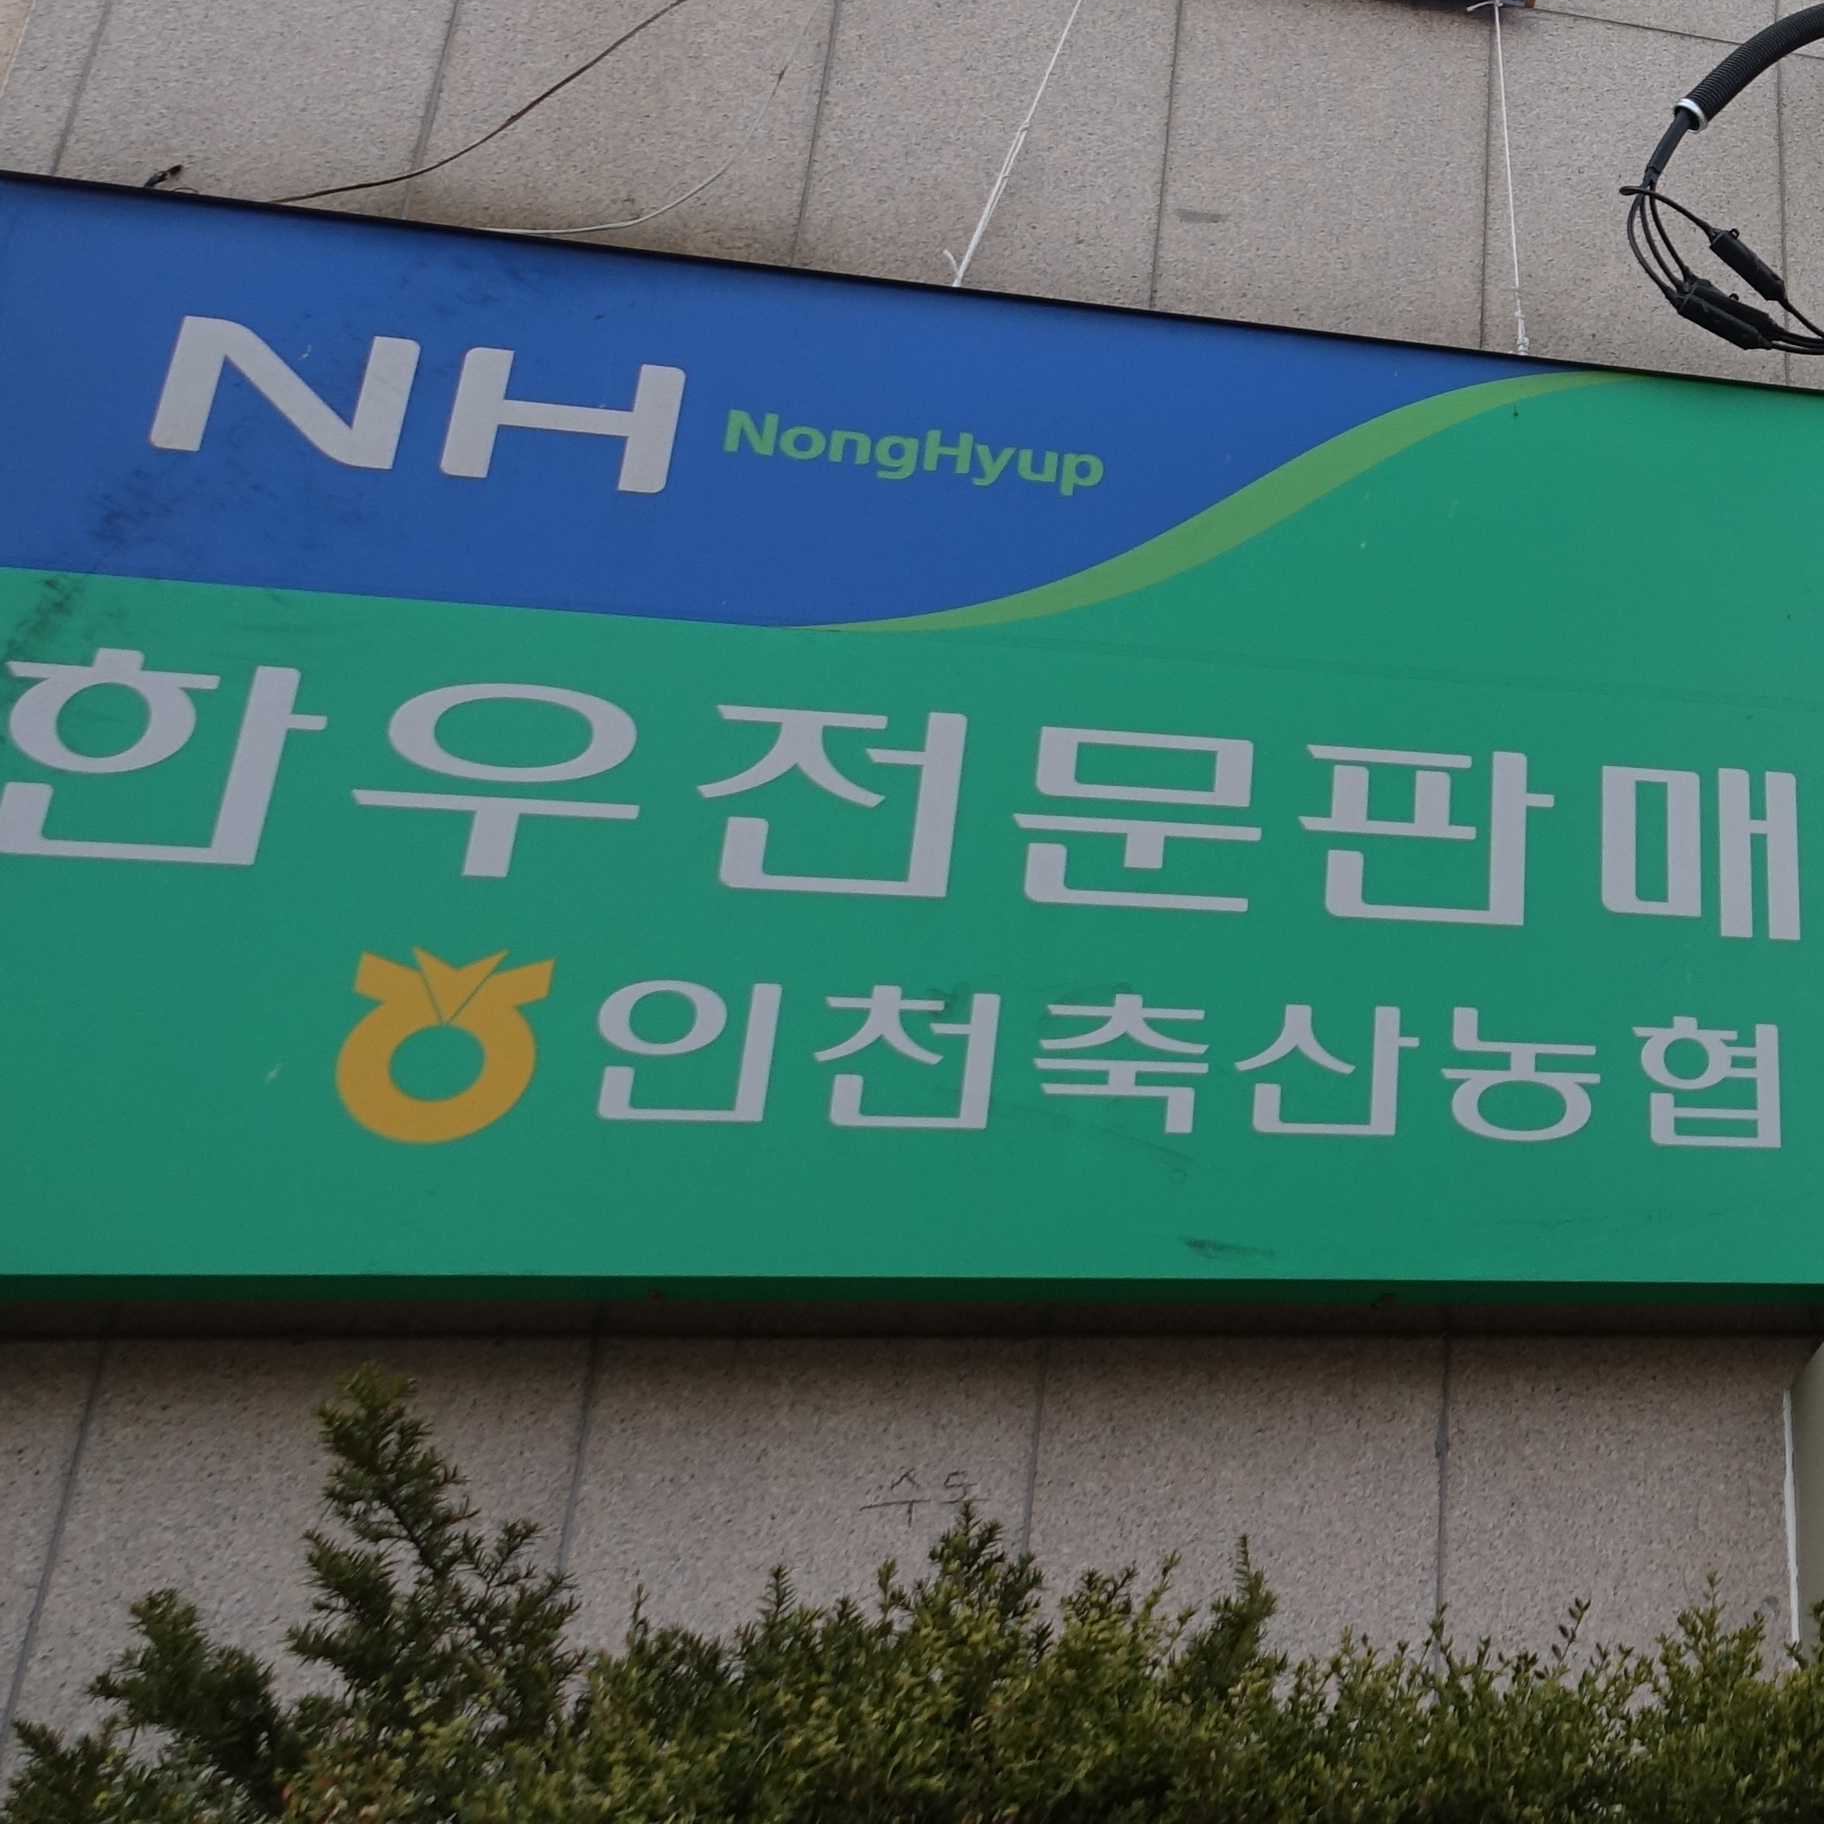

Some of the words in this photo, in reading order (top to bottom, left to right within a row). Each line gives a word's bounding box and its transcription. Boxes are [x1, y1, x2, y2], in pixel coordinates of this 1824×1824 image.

[150, 315, 685, 494] NH
[722, 408, 1105, 497] NongHyup
[597, 978, 1782, 1149] 인천축산농협
